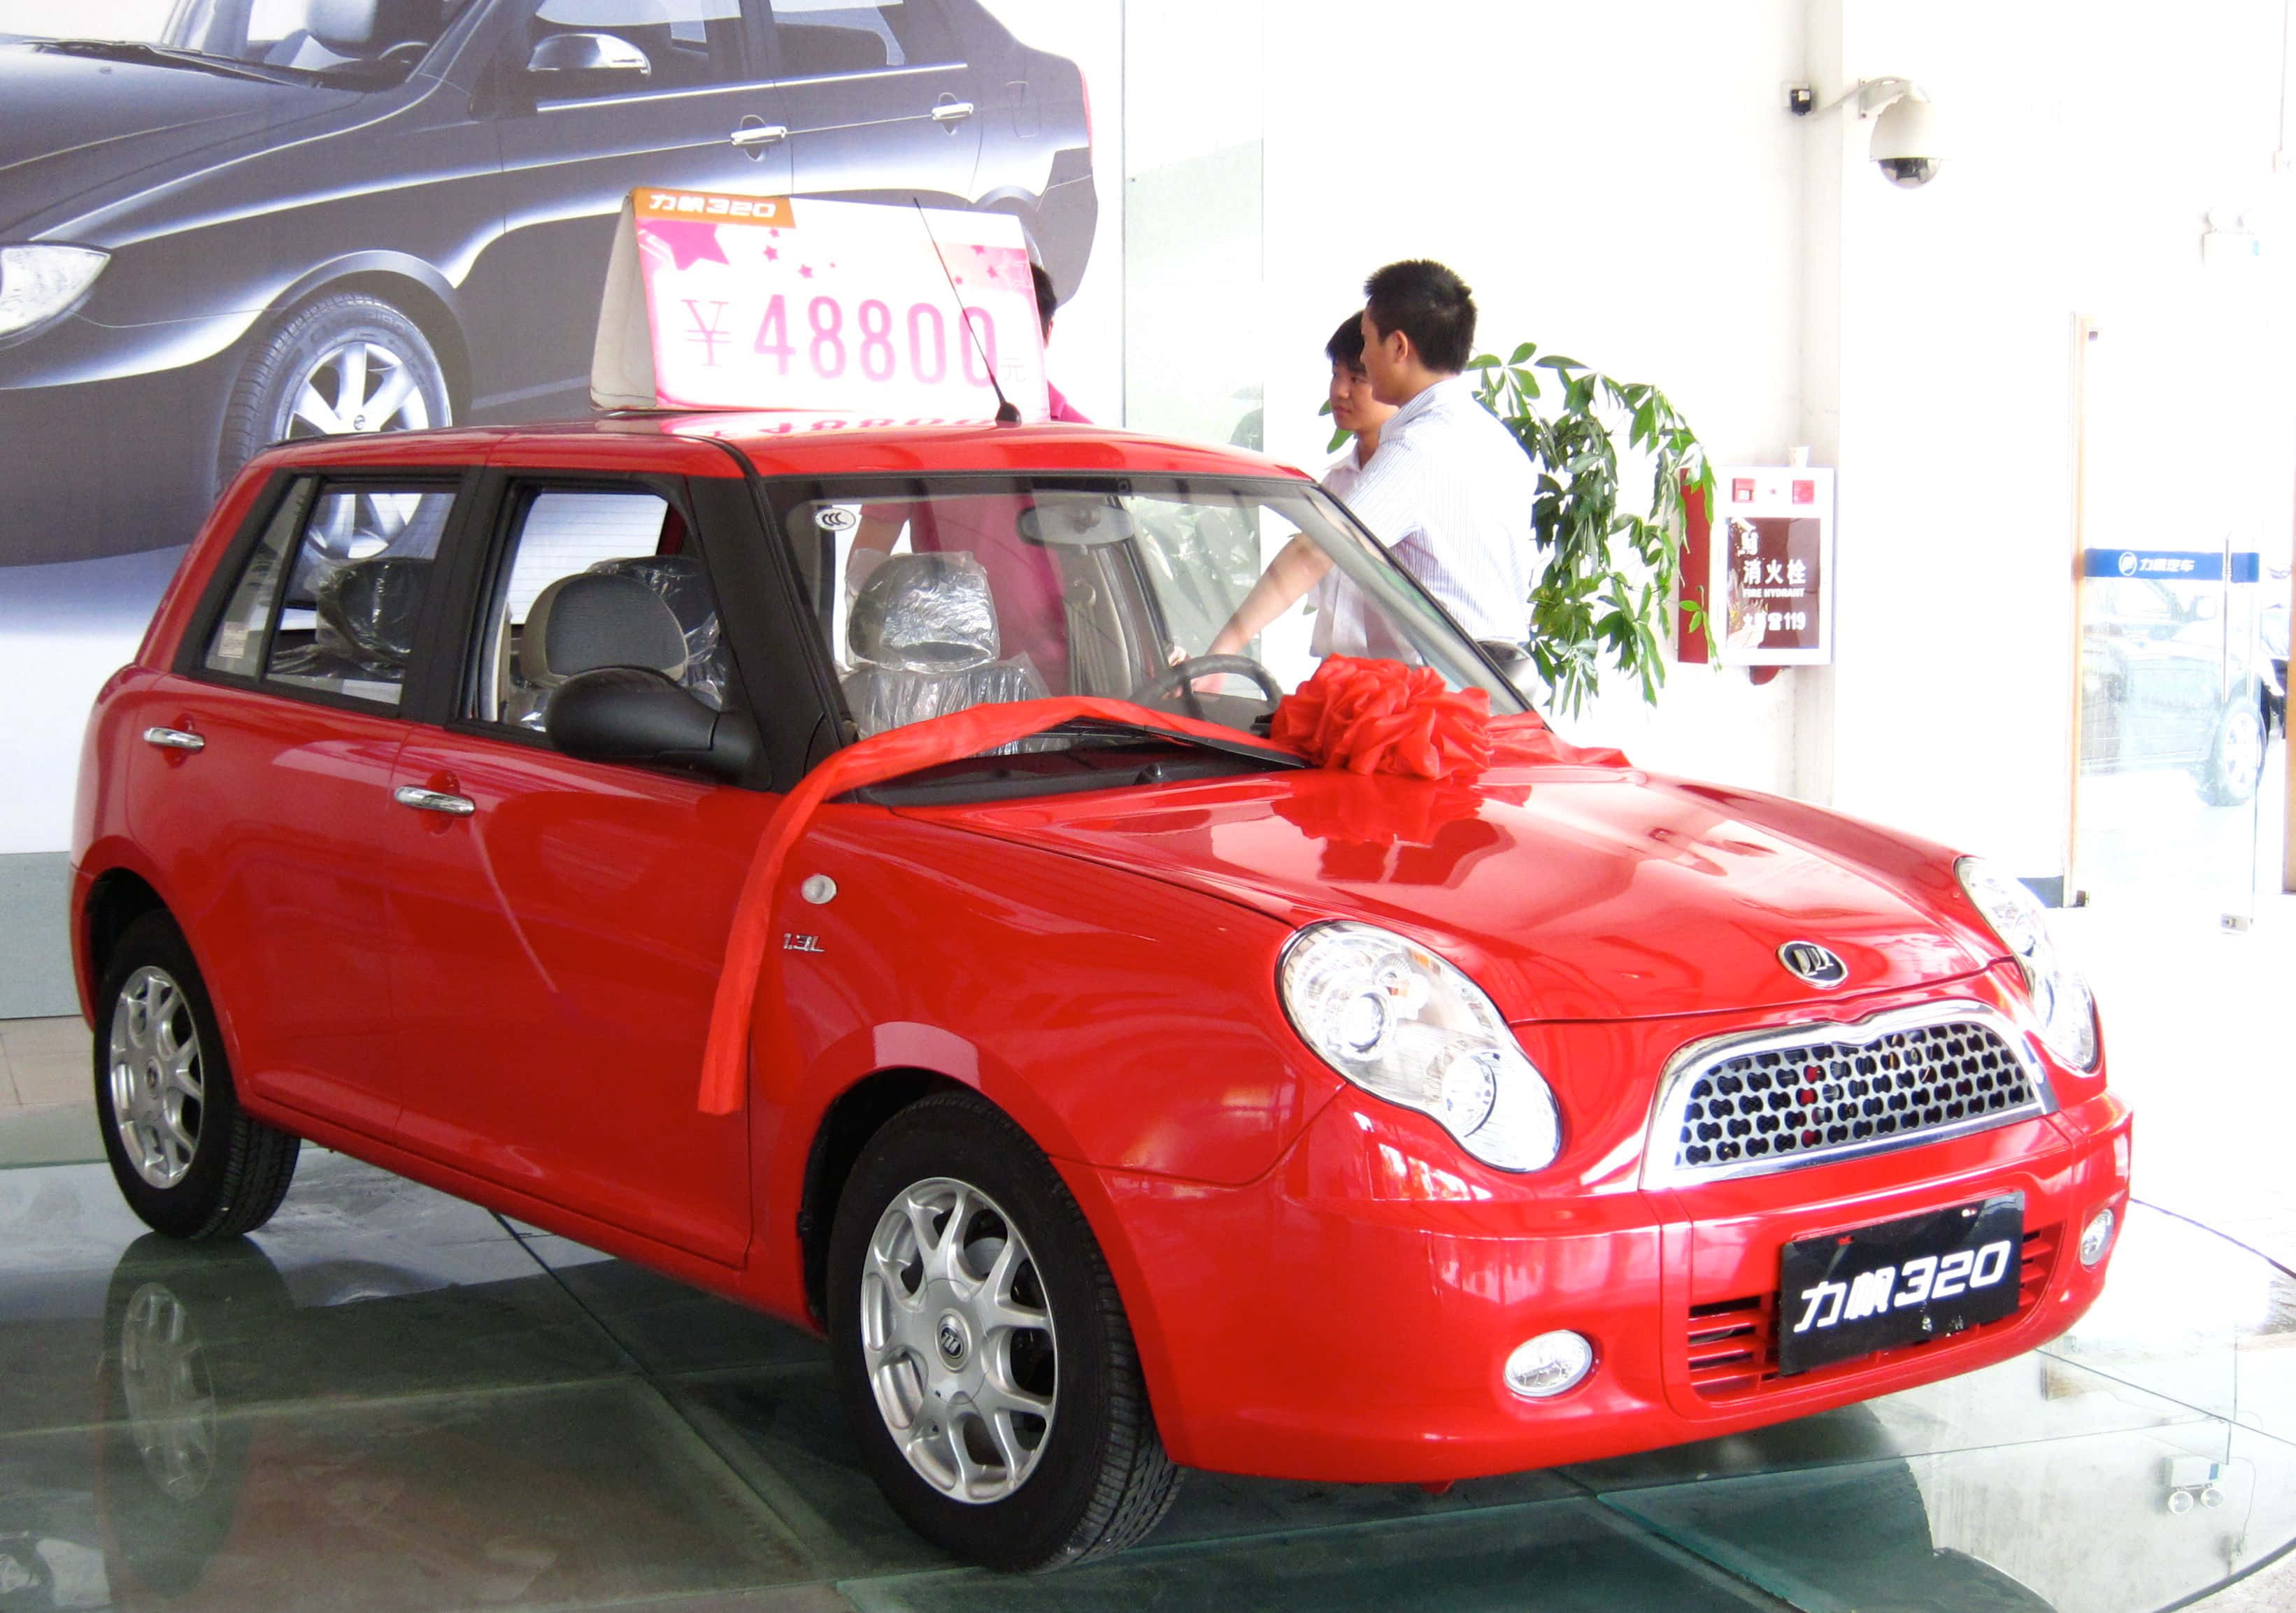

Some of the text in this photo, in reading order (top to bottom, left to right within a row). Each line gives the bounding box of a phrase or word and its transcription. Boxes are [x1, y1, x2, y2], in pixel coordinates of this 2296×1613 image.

[1744, 559, 1806, 585] 消火栓
[1784, 611, 1806, 631] 119
[1793, 1240, 2011, 1333] 力帆320
